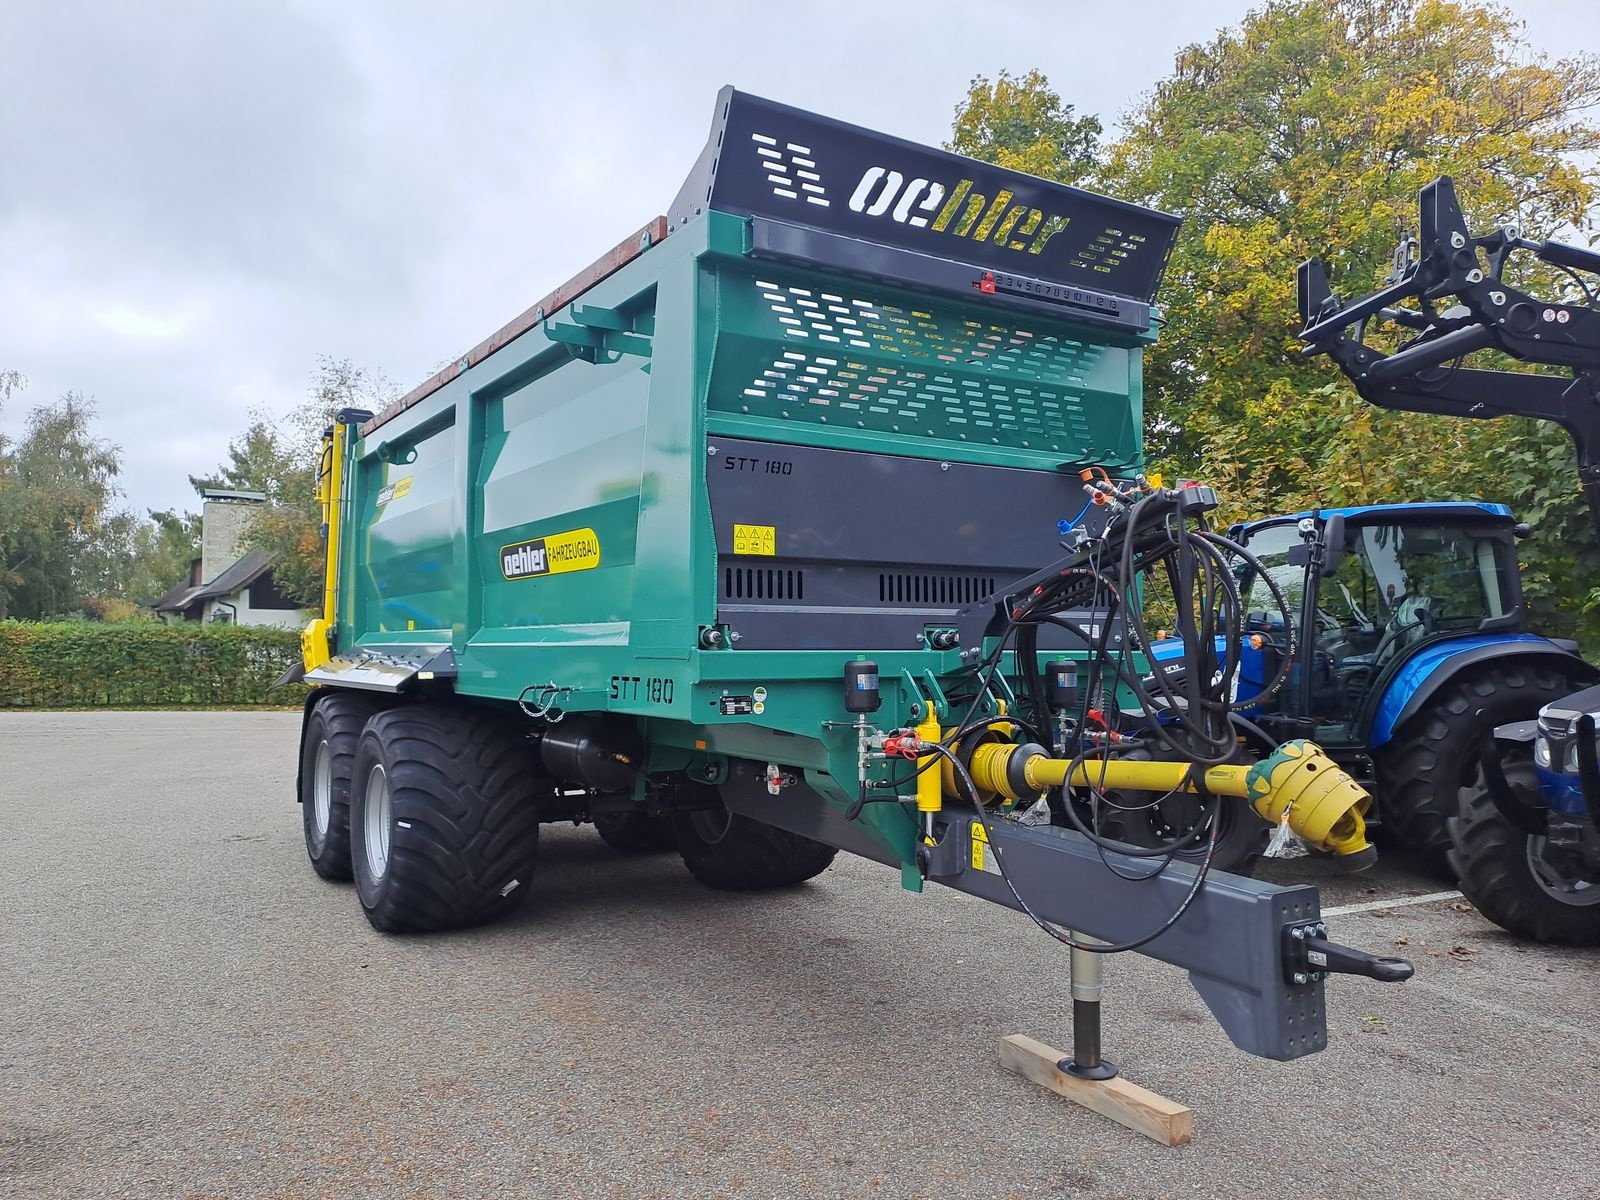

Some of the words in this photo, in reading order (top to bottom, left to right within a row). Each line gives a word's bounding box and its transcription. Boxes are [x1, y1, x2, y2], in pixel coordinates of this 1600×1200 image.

[848, 166, 1070, 254] oehler
[996, 276, 1003, 284] 2
[1007, 278, 1013, 286] 3
[1016, 280, 1022, 288] 4
[1035, 285, 1041, 293] 6
[1045, 286, 1051, 294] 7
[1054, 289, 1060, 297] 8
[1064, 290, 1070, 298] 9
[1074, 292, 1082, 302] 10
[1097, 297, 1104, 306] 12
[1110, 300, 1117, 309] 13
[724, 456, 759, 472] STT
[765, 461, 793, 476] 180
[503, 546, 546, 576] oehler
[548, 539, 598, 563] FAHRZEUGBAU
[610, 675, 641, 701] STT
[646, 677, 674, 704] 180
